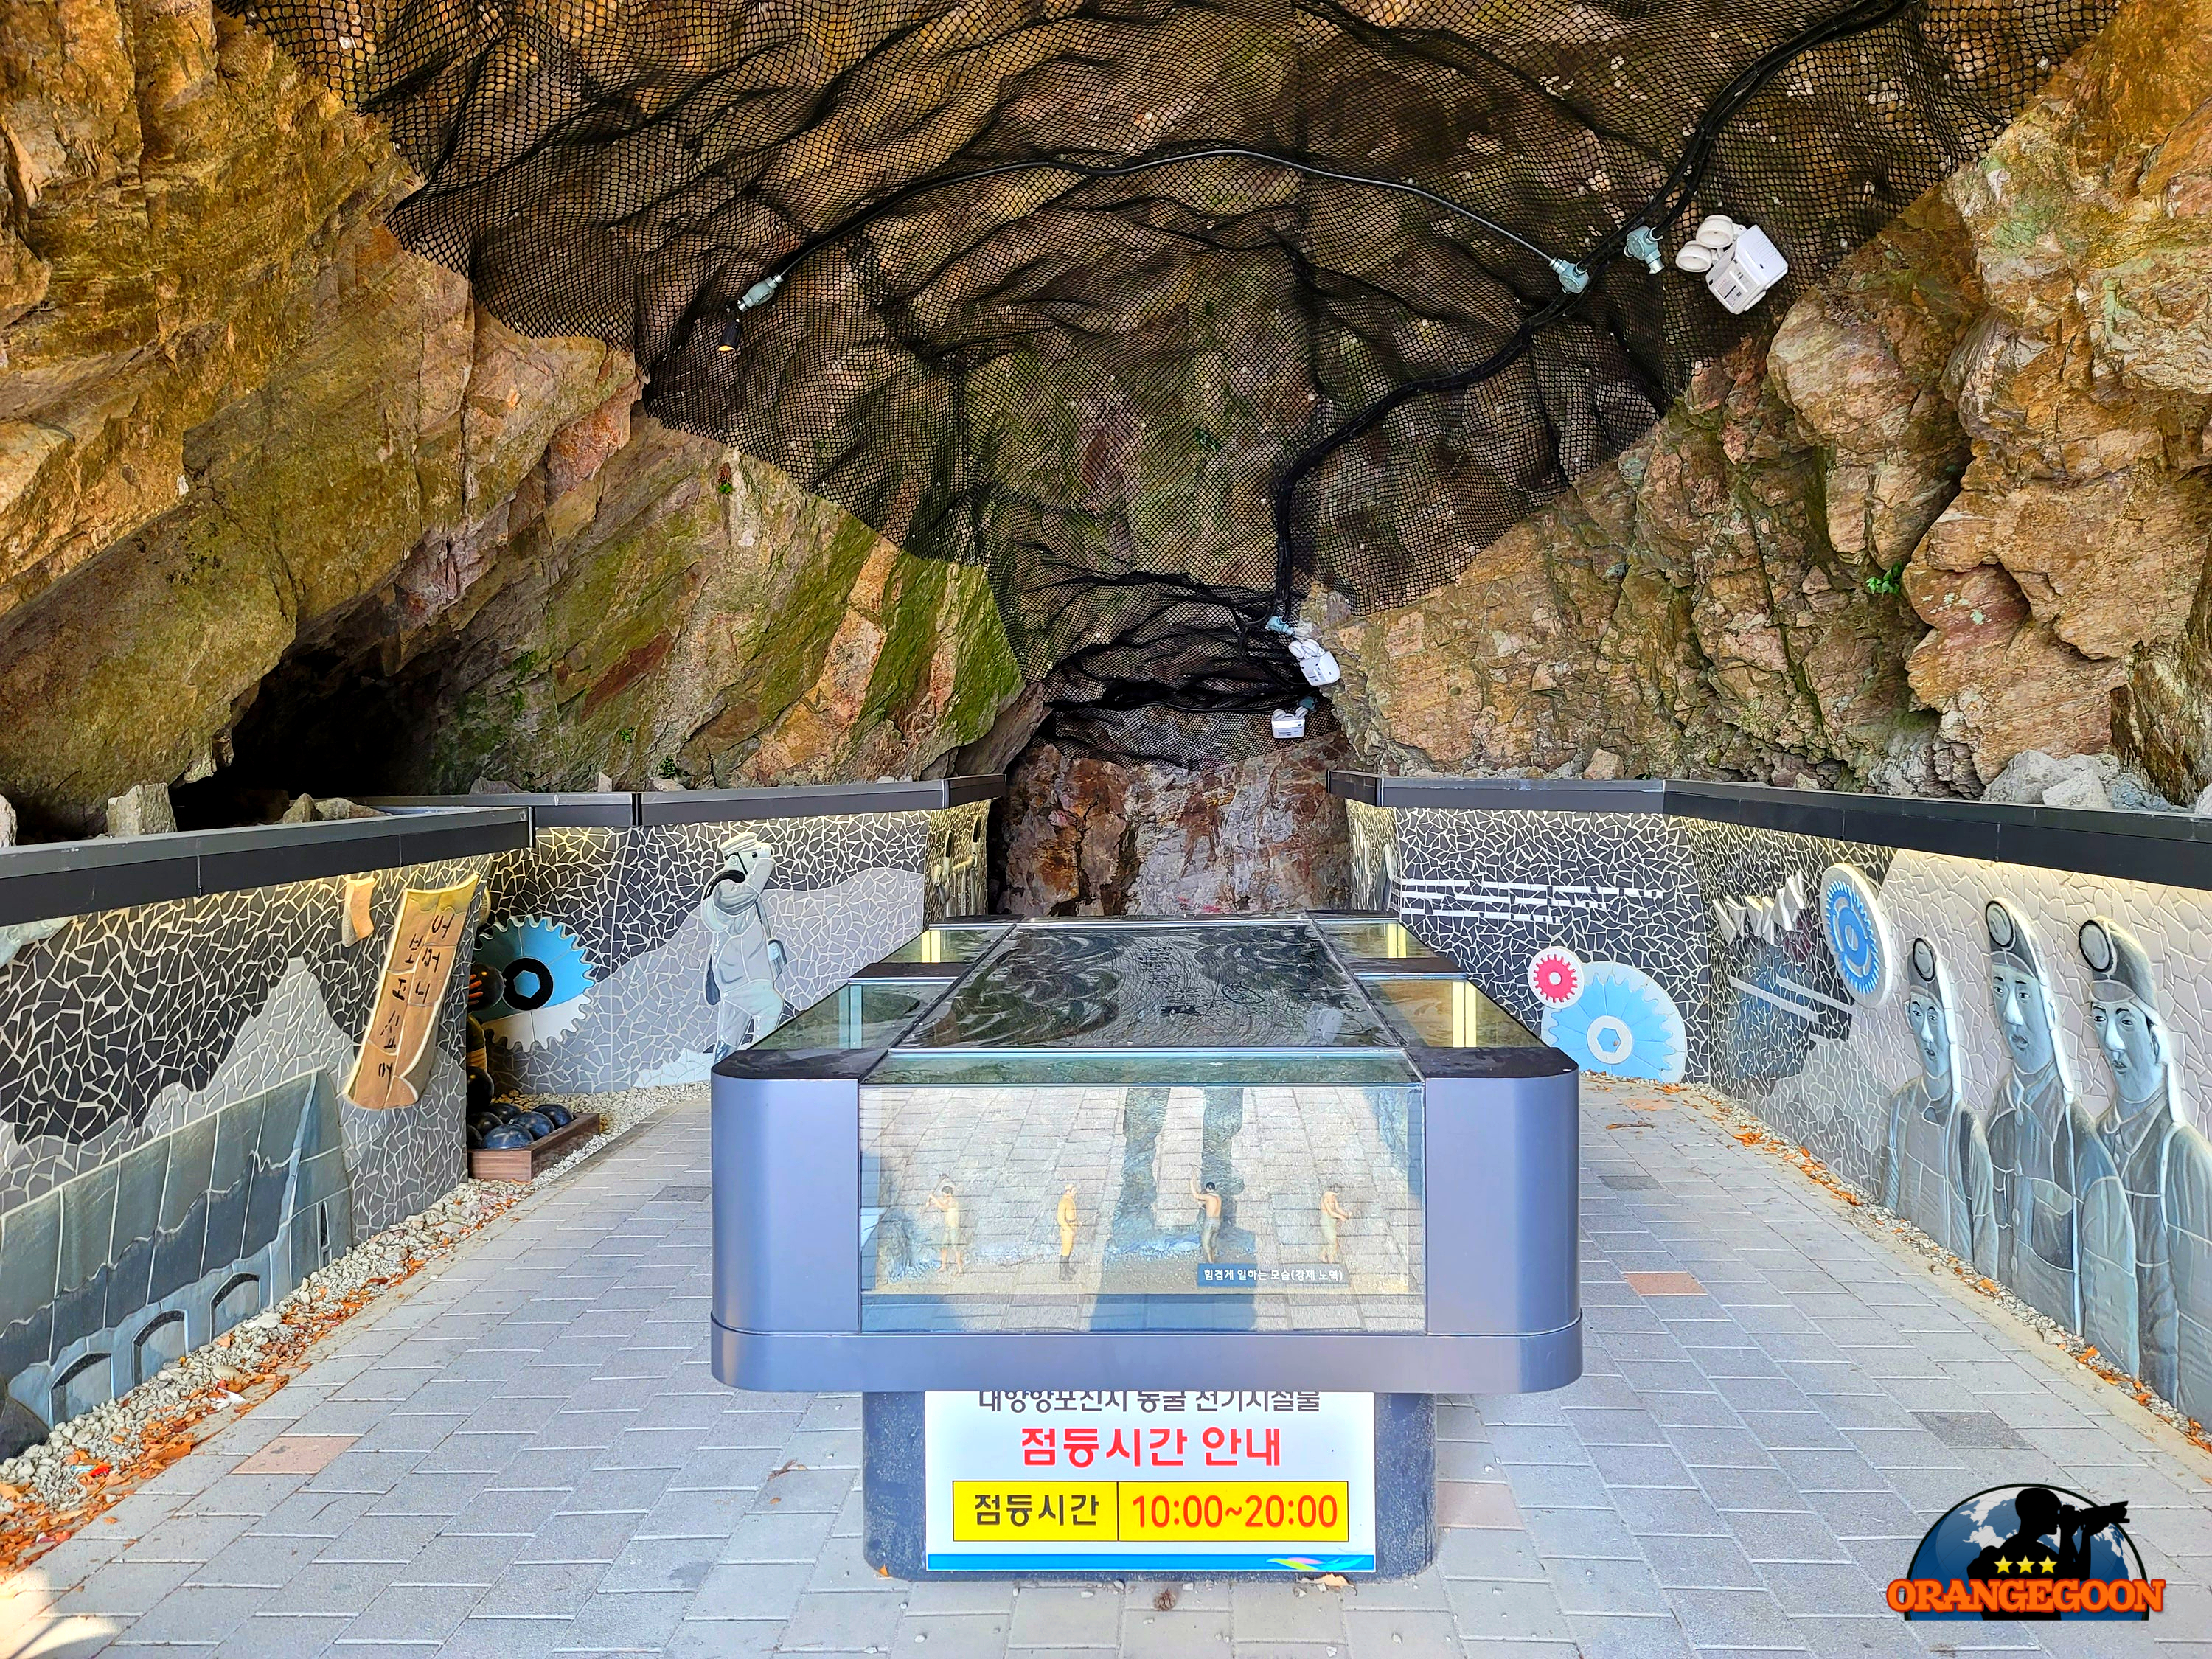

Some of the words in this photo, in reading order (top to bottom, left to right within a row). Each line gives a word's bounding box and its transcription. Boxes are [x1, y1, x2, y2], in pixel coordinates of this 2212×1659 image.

[1204, 1269, 1234, 1281] 힘겹게
[1237, 1269, 1267, 1281] 일하는
[1021, 1427, 1189, 1468] 점등시간
[1202, 1427, 1282, 1467] 안내
[974, 1494, 1100, 1526] 점등시간
[1131, 1495, 1338, 1529] 10:00~20:00
